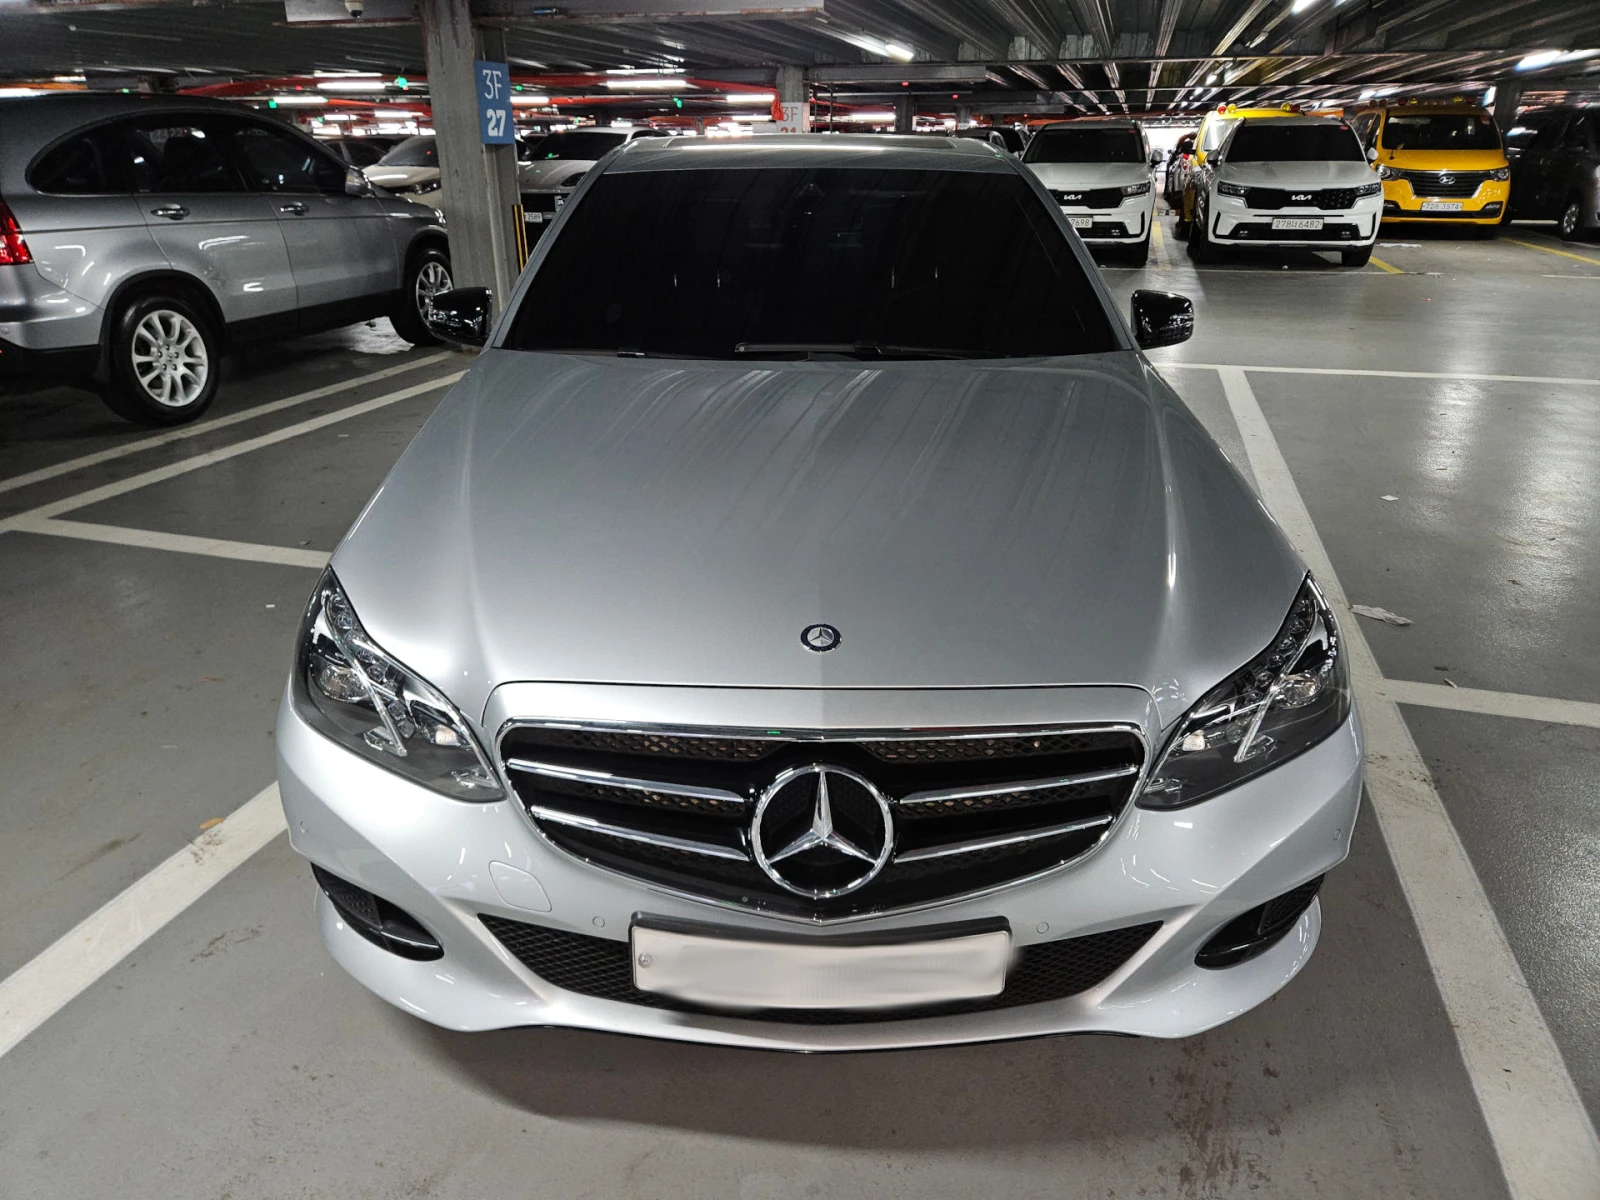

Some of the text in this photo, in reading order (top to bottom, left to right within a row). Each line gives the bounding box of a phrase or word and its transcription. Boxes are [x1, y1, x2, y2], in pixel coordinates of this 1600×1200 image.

[483, 69, 502, 100] 3F
[486, 108, 506, 137] 27
[782, 106, 798, 122] 3F
